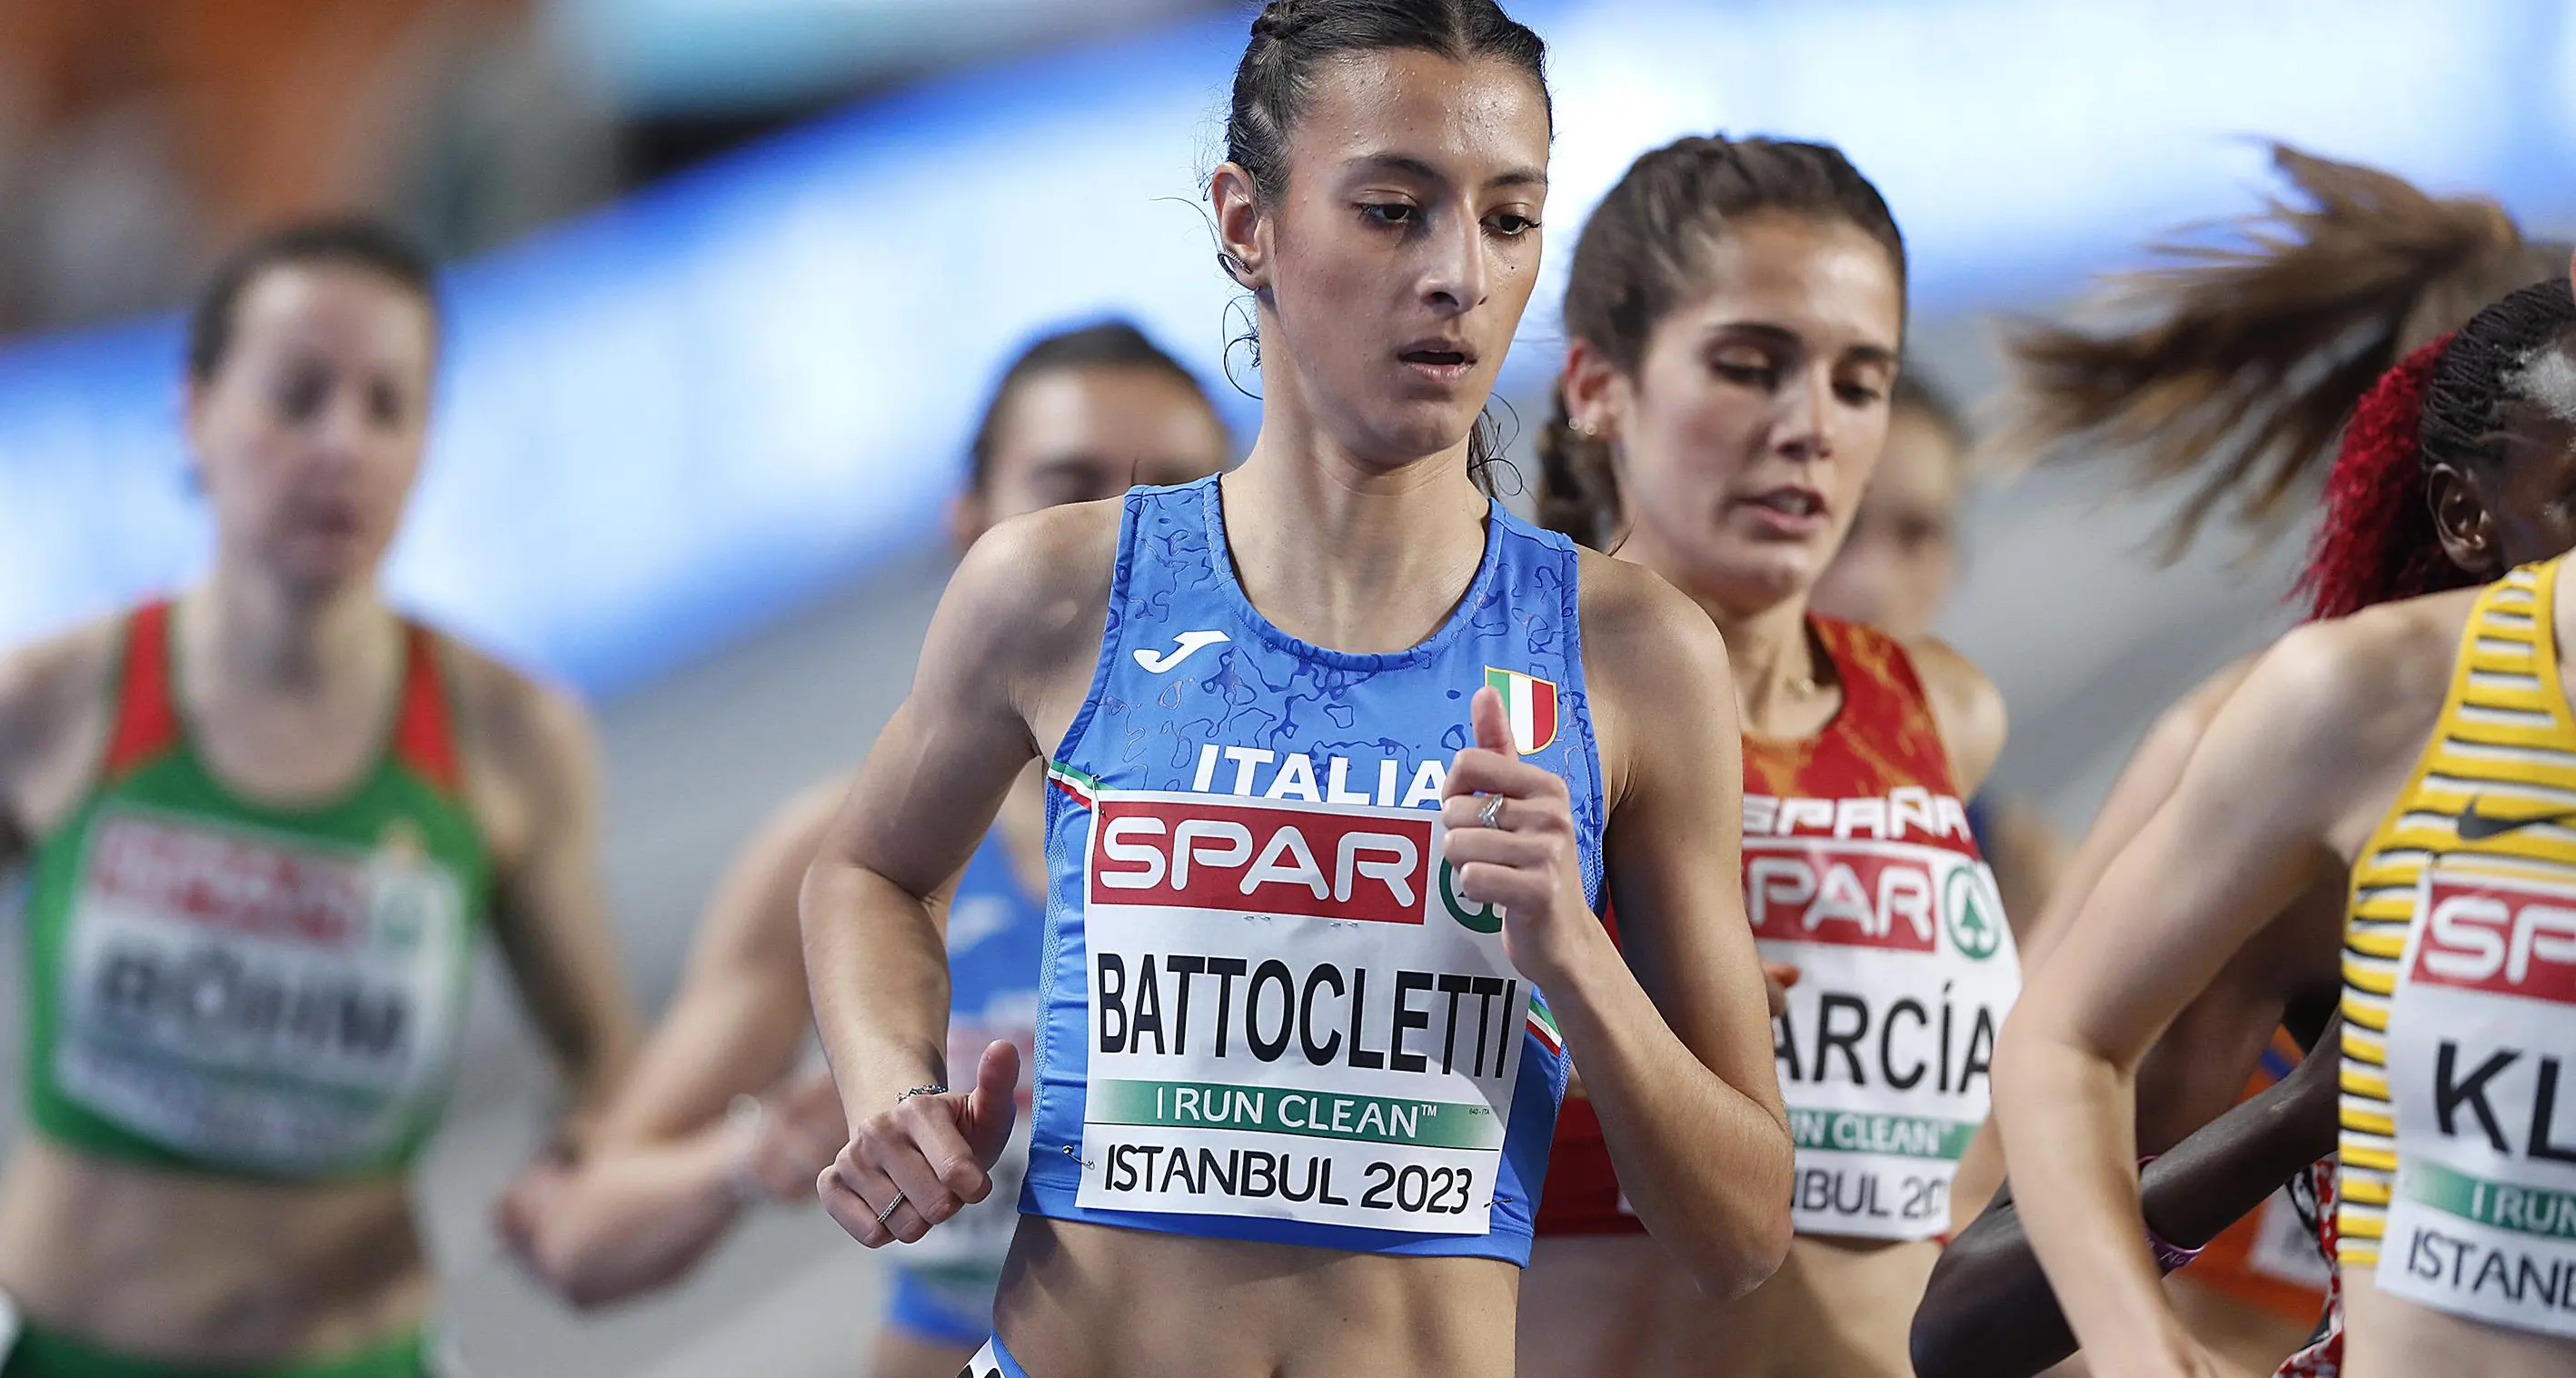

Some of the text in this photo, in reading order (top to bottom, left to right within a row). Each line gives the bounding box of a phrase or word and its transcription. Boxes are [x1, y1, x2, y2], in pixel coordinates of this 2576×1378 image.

[1191, 744, 1447, 809] ITALIA
[1743, 784, 1972, 843] SPAÑA
[1099, 816, 1418, 908] SPAR
[1748, 856, 1934, 942] PAR
[1098, 953, 1517, 1079] BATTOCLETTI
[1774, 980, 1994, 1093] ARCÍA
[1156, 1086, 1164, 1120] I
[1175, 1086, 1265, 1125] RUN
[2435, 1041, 2576, 1163] KL
[1104, 1143, 1473, 1215] ISTANBUL 2023
[2472, 1180, 2485, 1219] I
